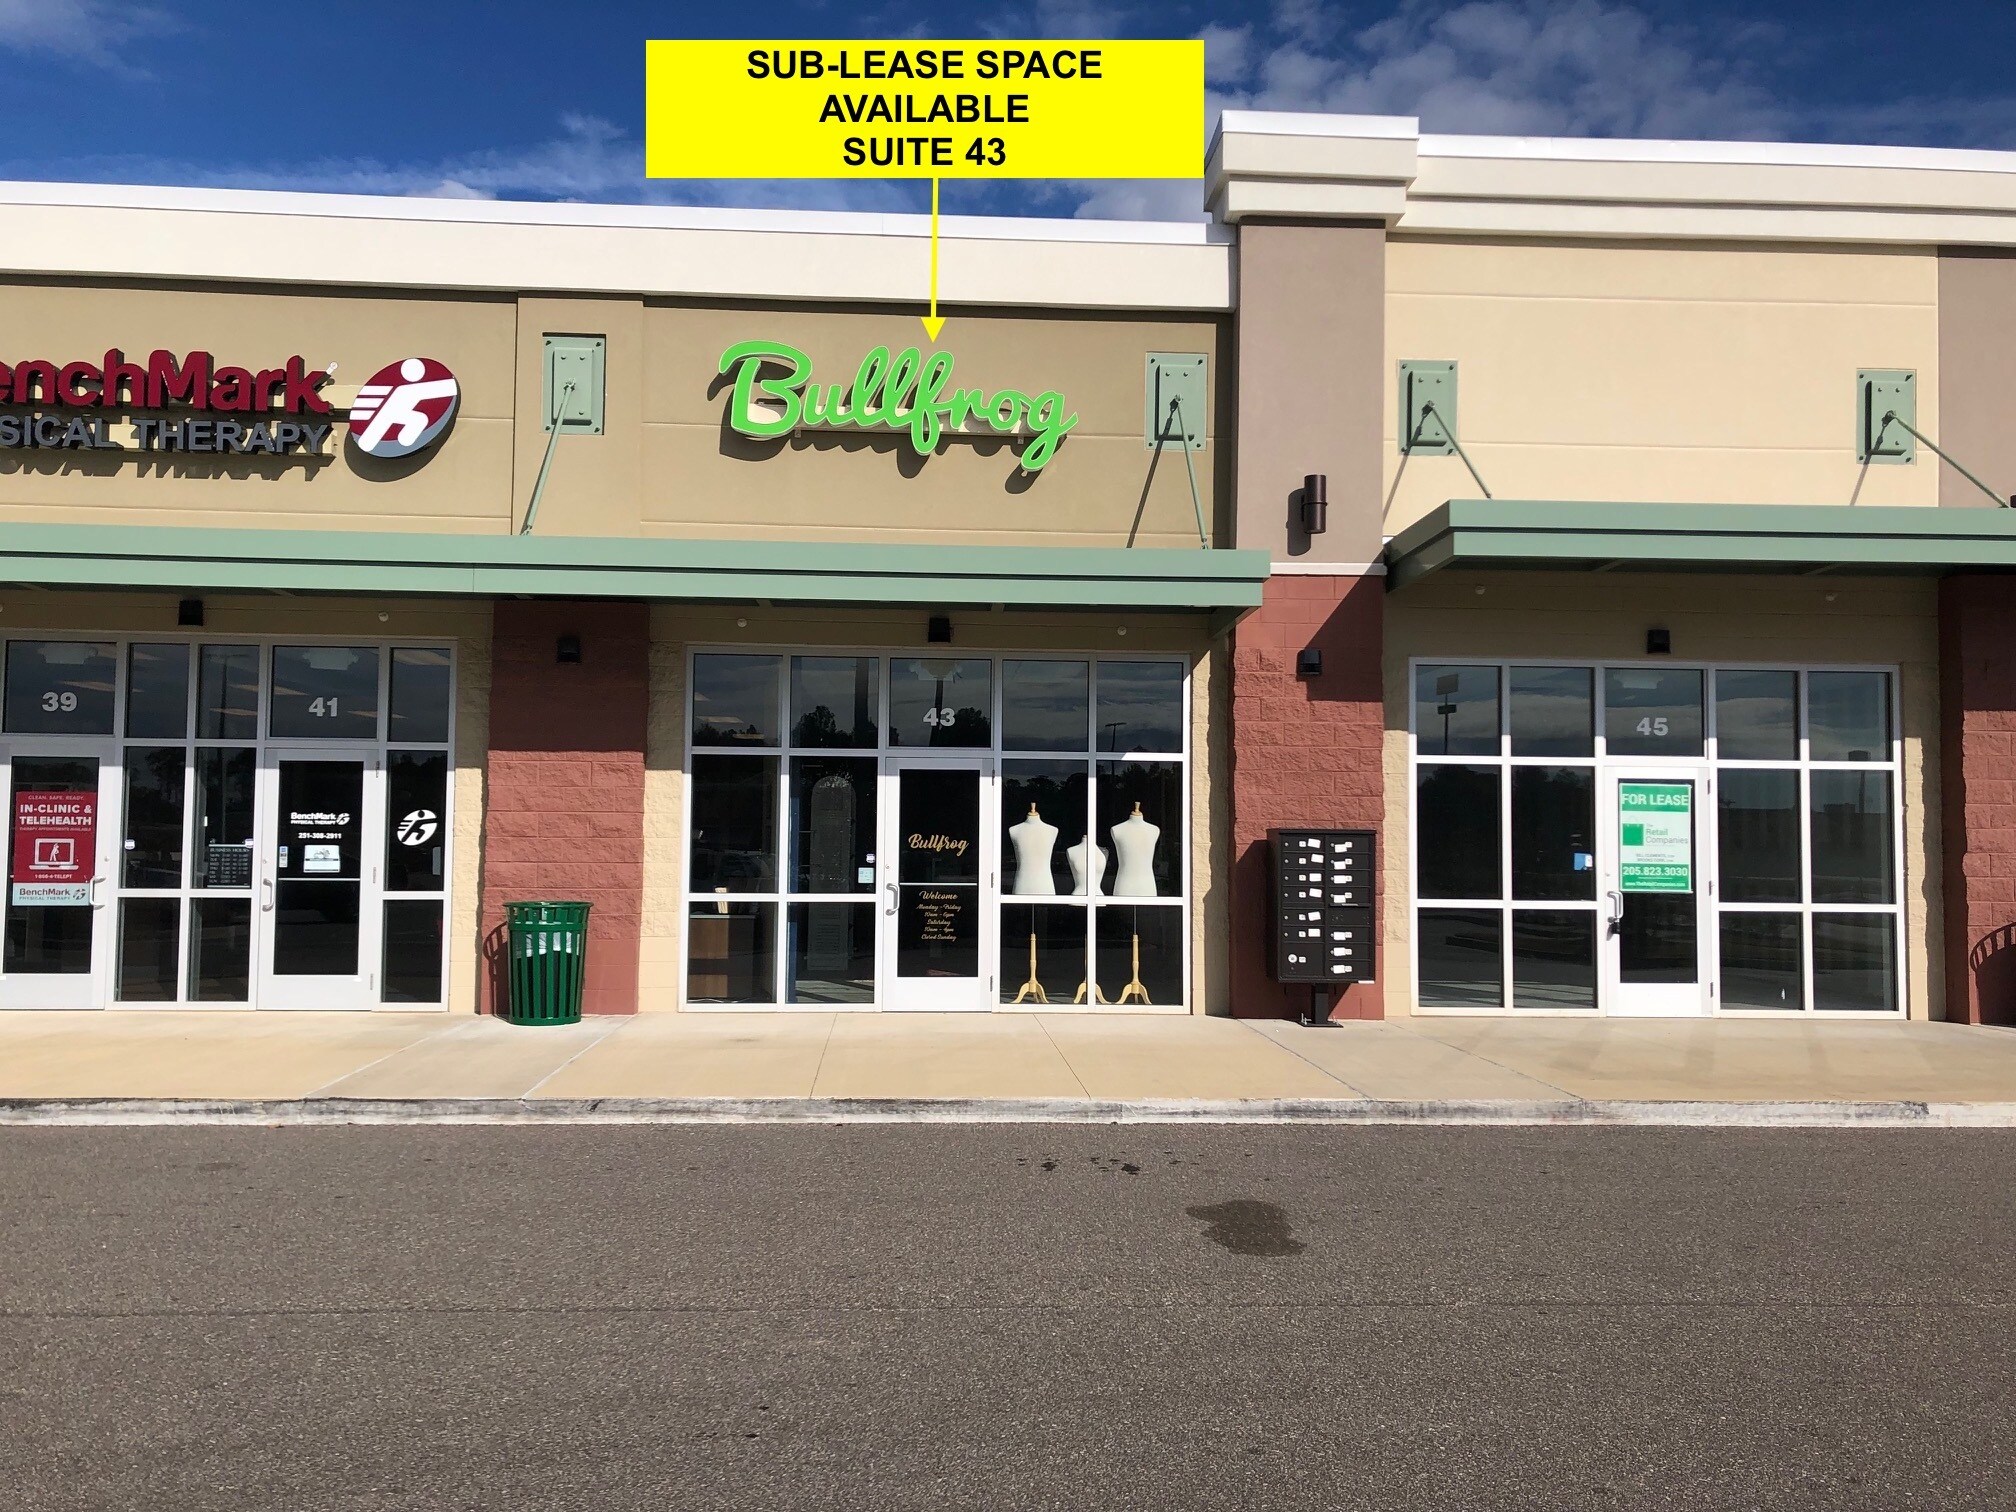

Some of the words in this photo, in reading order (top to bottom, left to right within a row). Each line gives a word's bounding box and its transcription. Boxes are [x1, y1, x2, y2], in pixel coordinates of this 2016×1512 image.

[0, 348, 331, 414] nchMark
[719, 340, 1079, 471] Bullfrog
[133, 418, 329, 453] THERAPY
[42, 691, 78, 712] 39
[308, 697, 338, 717] 41
[923, 707, 955, 727] 43
[1636, 717, 1669, 736] 45
[1621, 793, 1647, 805] FOR
[1649, 794, 1689, 806] LEASE
[20, 804, 80, 813] IN-CLINIC
[84, 805, 92, 813] &
[19, 816, 92, 825] TELEHEALTH
[290, 812, 336, 820] BenchMark
[908, 833, 969, 857] Bullfrog
[1645, 836, 1689, 845] Companies
[1622, 866, 1689, 876] 205.823.3030
[19, 888, 71, 896] BenchMark
[919, 890, 959, 900] Welcome
[943, 904, 961, 912] Friday
[926, 919, 951, 927] Saturday
[937, 934, 957, 942] Sunday
